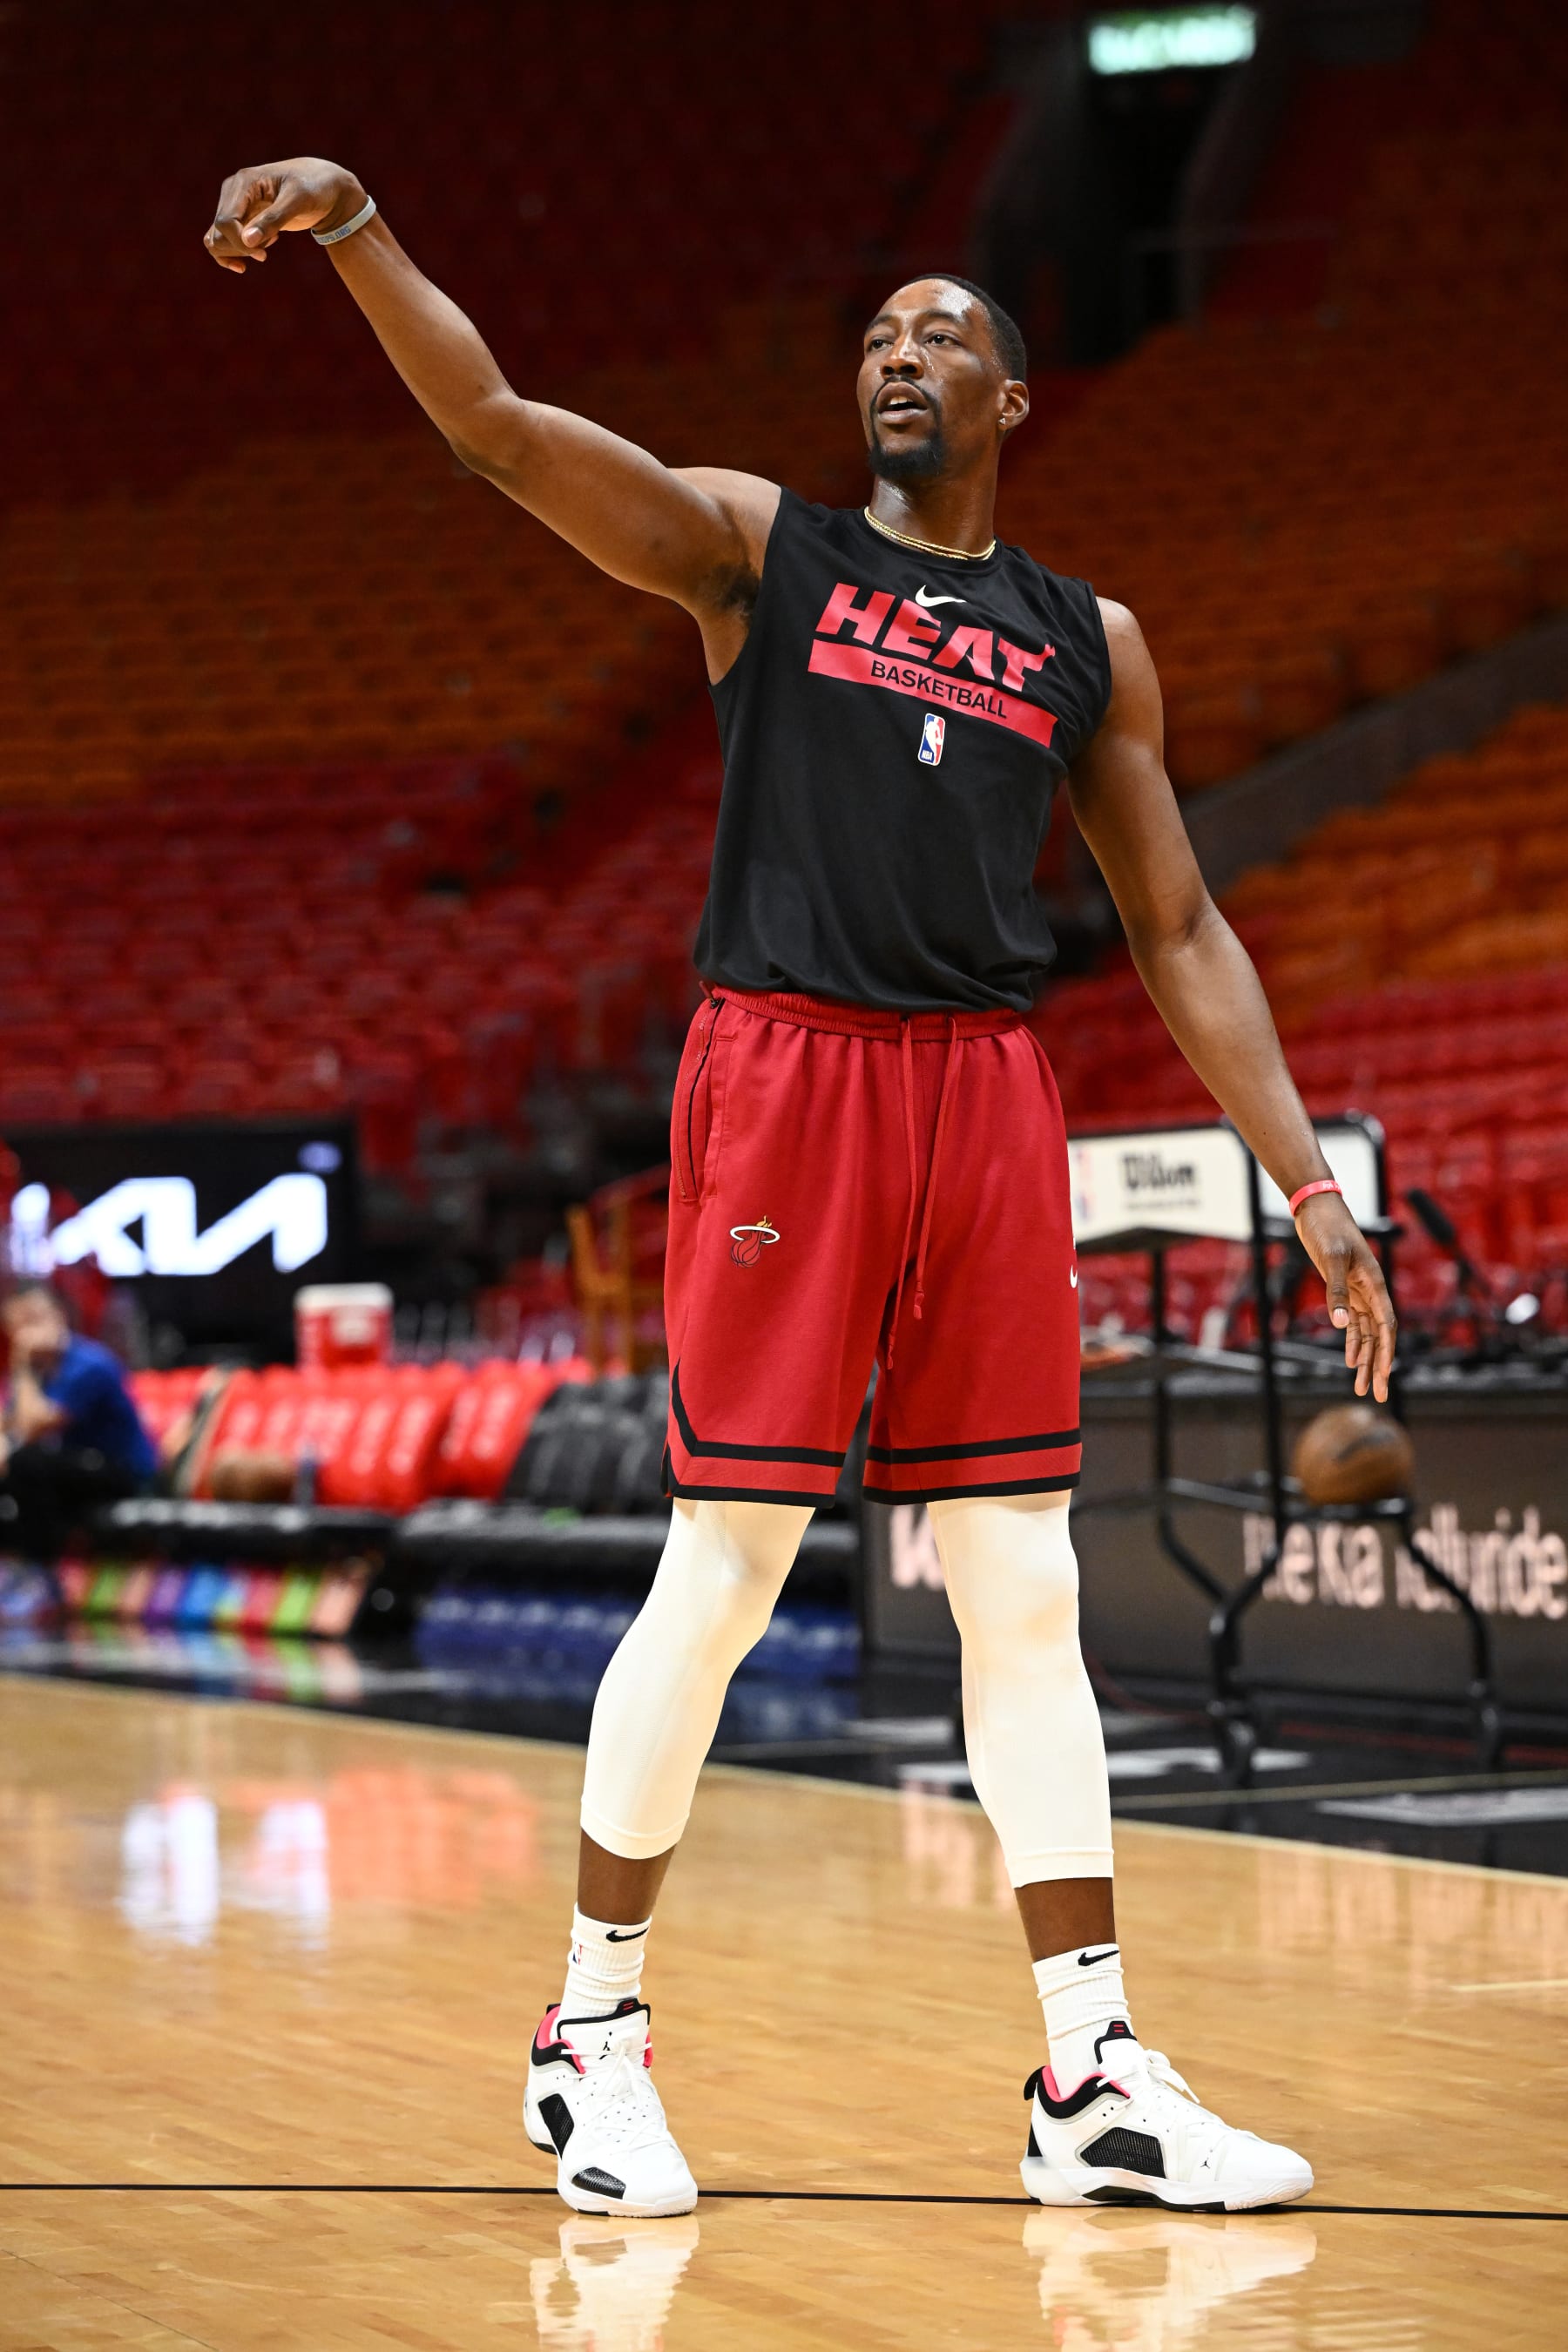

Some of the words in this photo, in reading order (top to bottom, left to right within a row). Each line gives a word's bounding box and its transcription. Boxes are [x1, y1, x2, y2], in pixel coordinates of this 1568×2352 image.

[815, 582, 1056, 692] HEAT
[871, 659, 1007, 719] BASKETBALL
[921, 749, 933, 761] NBA
